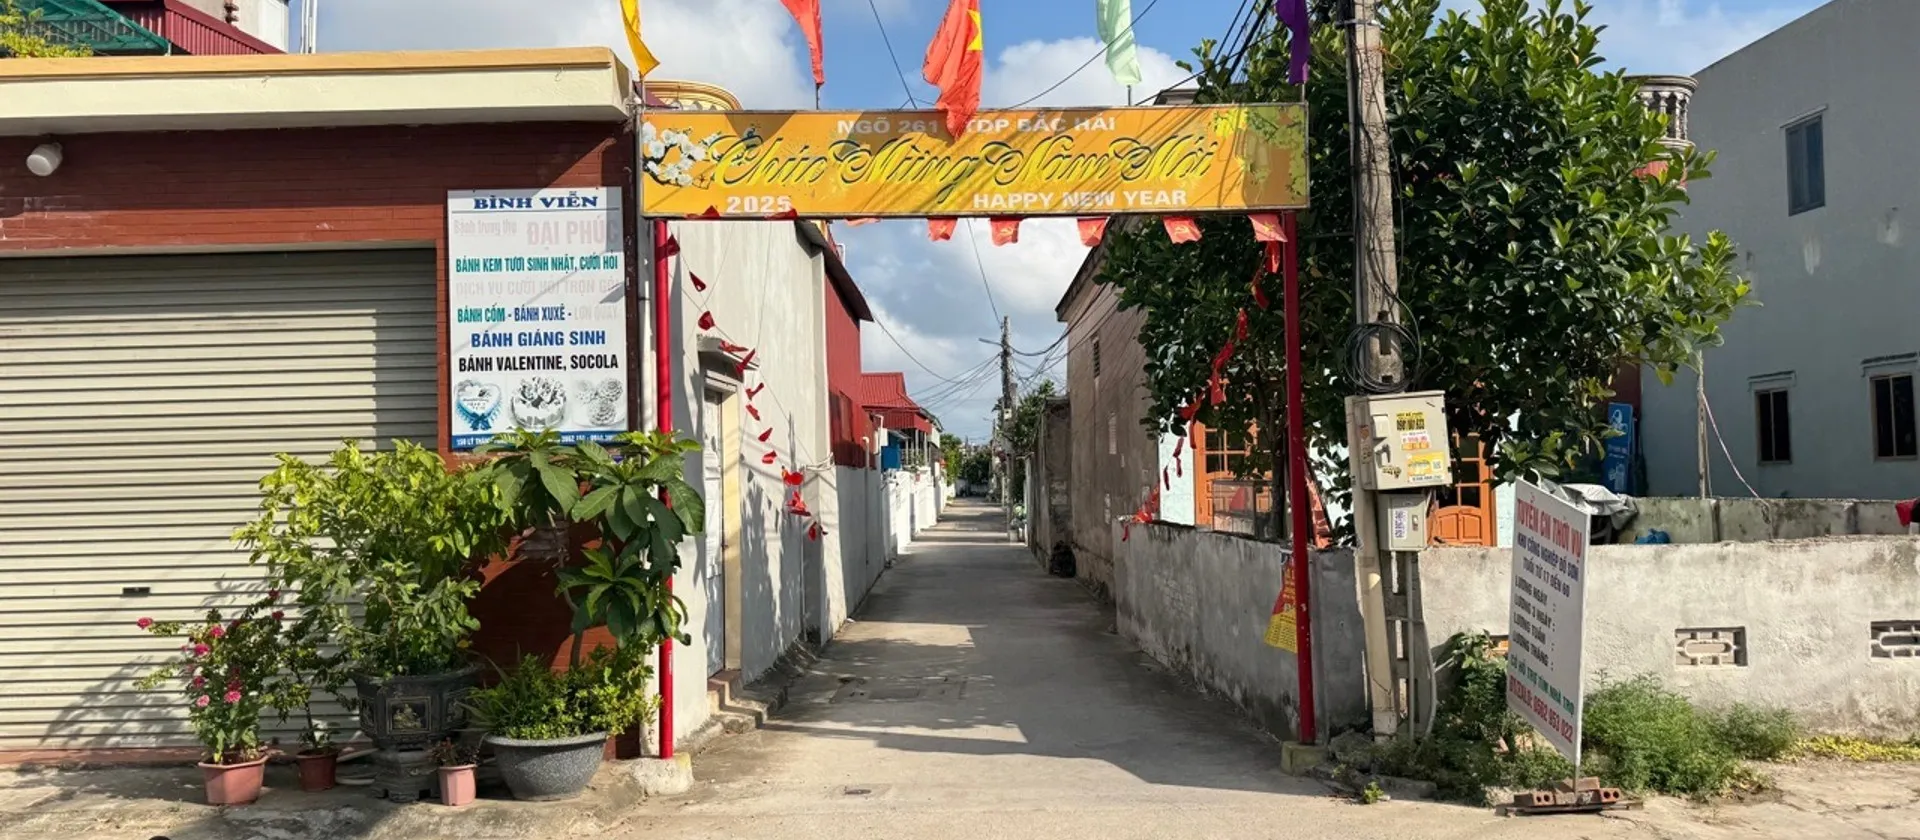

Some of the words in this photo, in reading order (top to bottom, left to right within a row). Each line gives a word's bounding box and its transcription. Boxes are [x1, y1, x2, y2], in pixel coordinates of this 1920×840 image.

[837, 116, 891, 134] NGÕ
[898, 119, 939, 134] 261
[1016, 111, 1067, 132] BẮC
[473, 194, 533, 210] BÌNH
[539, 190, 599, 209] VIỄN
[725, 194, 793, 213] 2025
[973, 191, 1055, 209] HAPPY
[1061, 190, 1116, 208] NEW
[1123, 188, 1188, 206] YEAR
[455, 255, 481, 273] BÁNH
[482, 256, 503, 273] KEM
[527, 256, 550, 272] SINH
[457, 305, 482, 323] BÁNH
[513, 303, 540, 322] BÁNH
[470, 329, 513, 348] BÁNH
[517, 328, 565, 347] GIÁNG
[569, 330, 606, 346] SINH
[458, 354, 493, 372] BÁNH
[496, 355, 567, 372] VALENTINE,
[570, 353, 619, 370] SOCOLA
